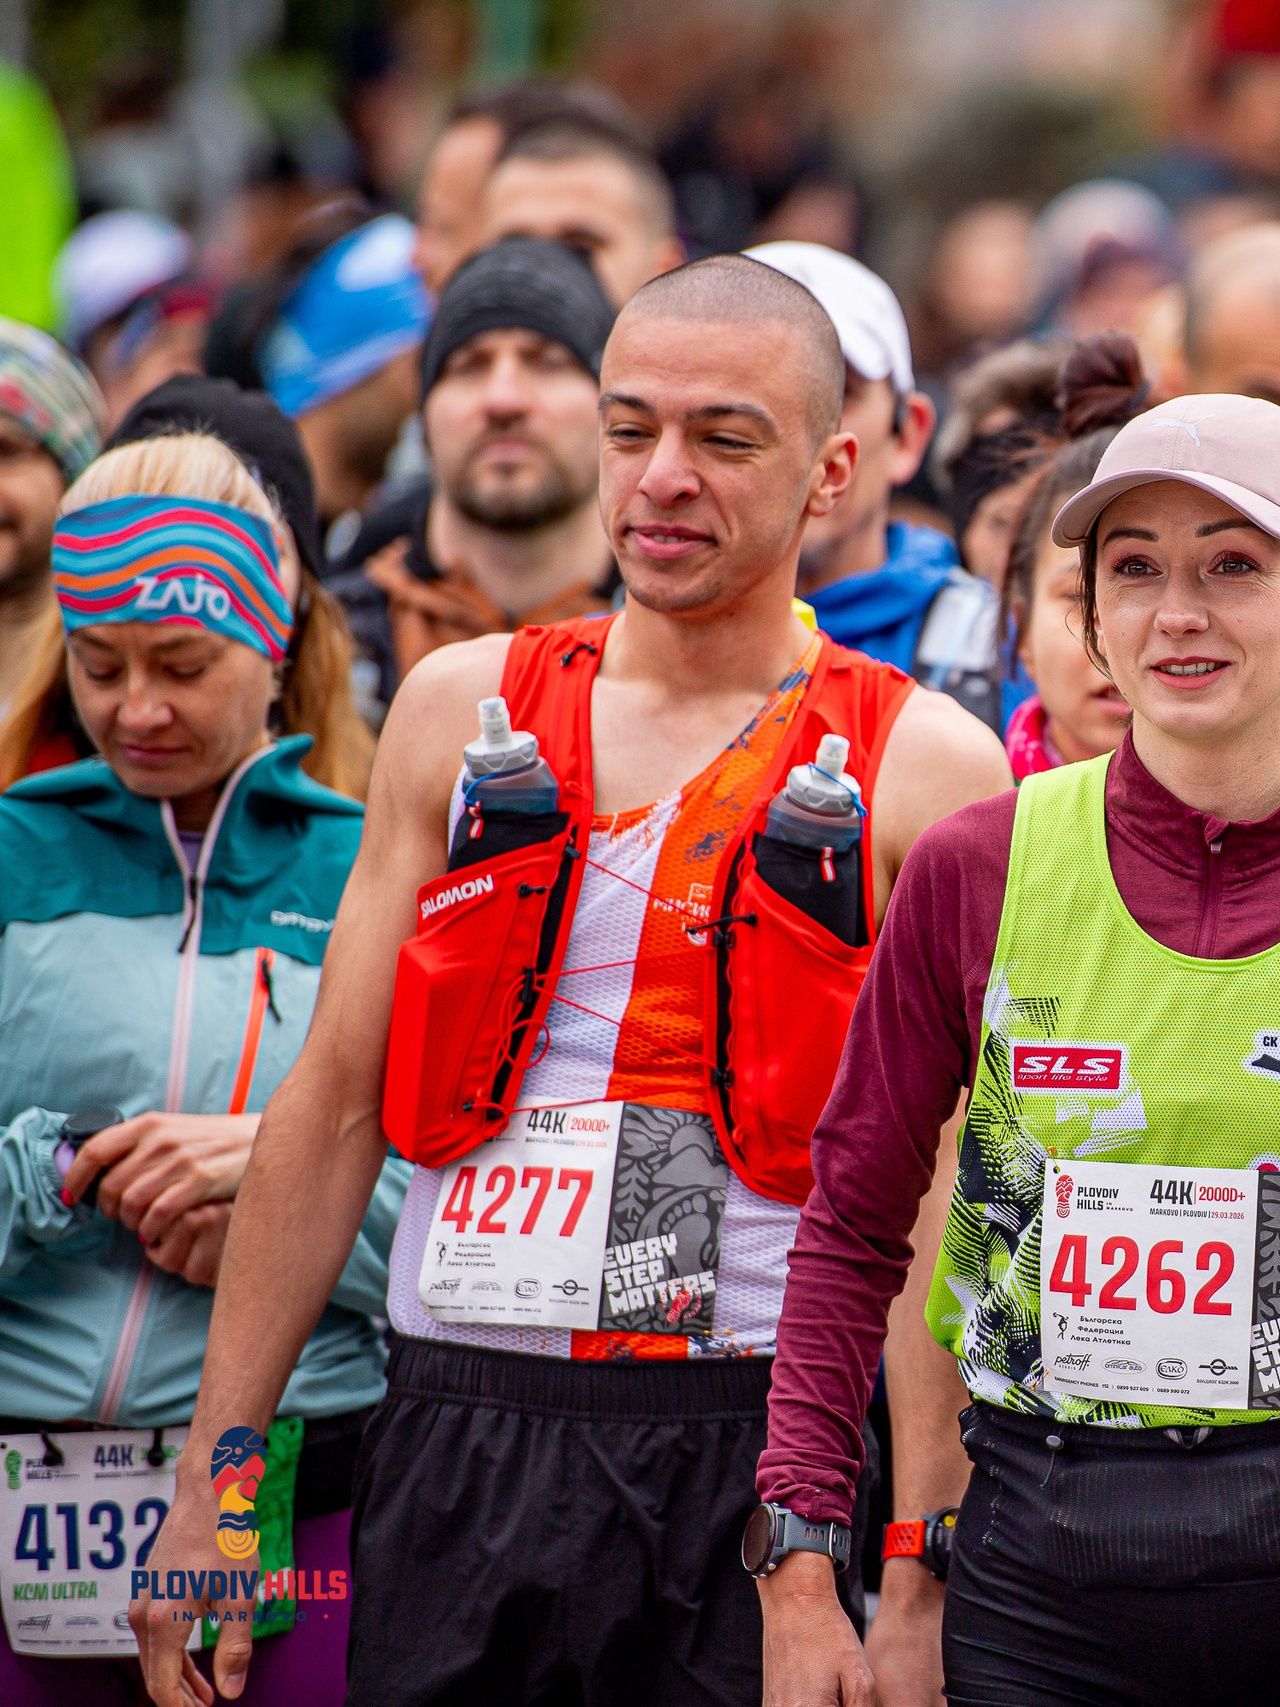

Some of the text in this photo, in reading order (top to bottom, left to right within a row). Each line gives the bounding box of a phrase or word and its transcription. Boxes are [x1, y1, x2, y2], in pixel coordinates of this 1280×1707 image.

[421, 874, 494, 920] SALOMON
[1018, 1056, 1115, 1075] SLS
[1017, 1073, 1048, 1081] sport
[527, 1109, 567, 1134] 44K
[441, 1165, 594, 1237] 4277
[1077, 1186, 1119, 1199] PLOVDIV
[1149, 1179, 1246, 1205] 44K 2000D+
[1077, 1199, 1104, 1211] HILLS
[1149, 1208, 1245, 1220] MARKOVO PLOVDIV 29.03.2026
[603, 1233, 678, 1270] EVERY
[604, 1259, 665, 1293] STEP
[1049, 1234, 1235, 1316] 4262
[608, 1270, 717, 1316] MATTERS
[1077, 1325, 1124, 1335] Федерация
[1080, 1315, 1122, 1326] Българска
[1070, 1335, 1131, 1346] Лека Атлетика
[1054, 1376, 1080, 1385] EMERGENCY
[1080, 1380, 1099, 1388] PHONES
[94, 1444, 135, 1468] 44K
[14, 1498, 171, 1572] 4132
[13, 1580, 98, 1601] KCM ULTRA
